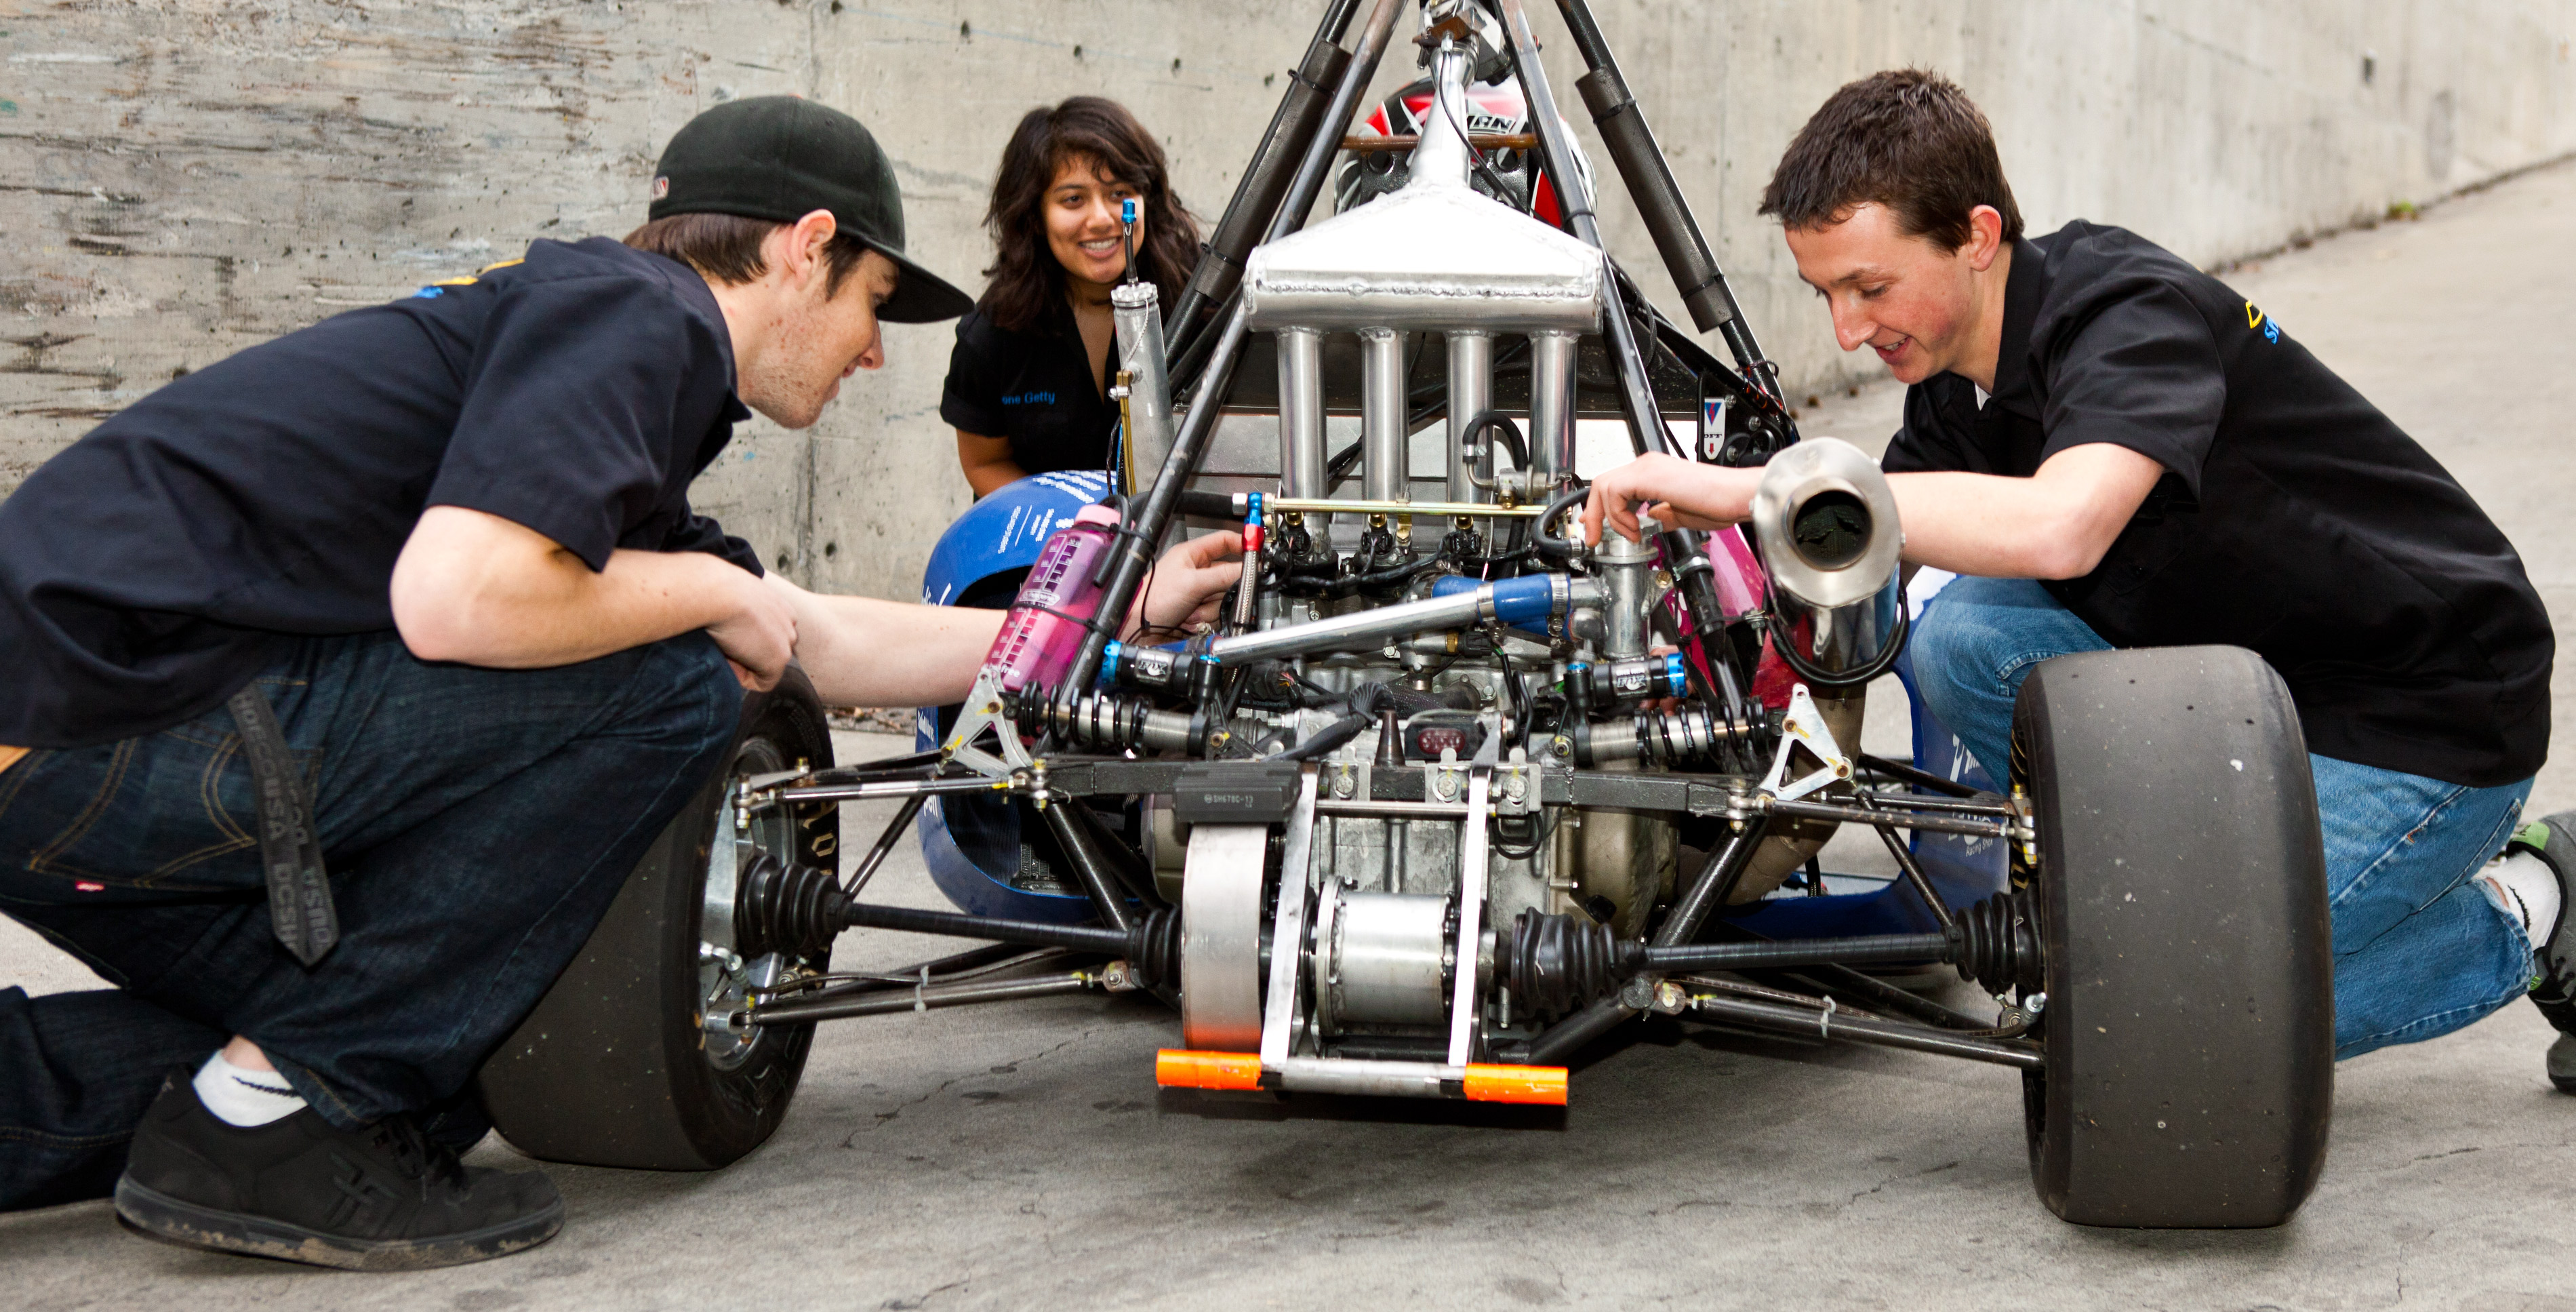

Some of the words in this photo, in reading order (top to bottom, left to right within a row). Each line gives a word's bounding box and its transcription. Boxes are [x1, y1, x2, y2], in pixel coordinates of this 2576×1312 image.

[1024, 391, 1055, 405] Getty
[1138, 660, 1168, 676] FOX
[1617, 676, 1647, 690] FOX
[1965, 842, 1981, 858] Racing
